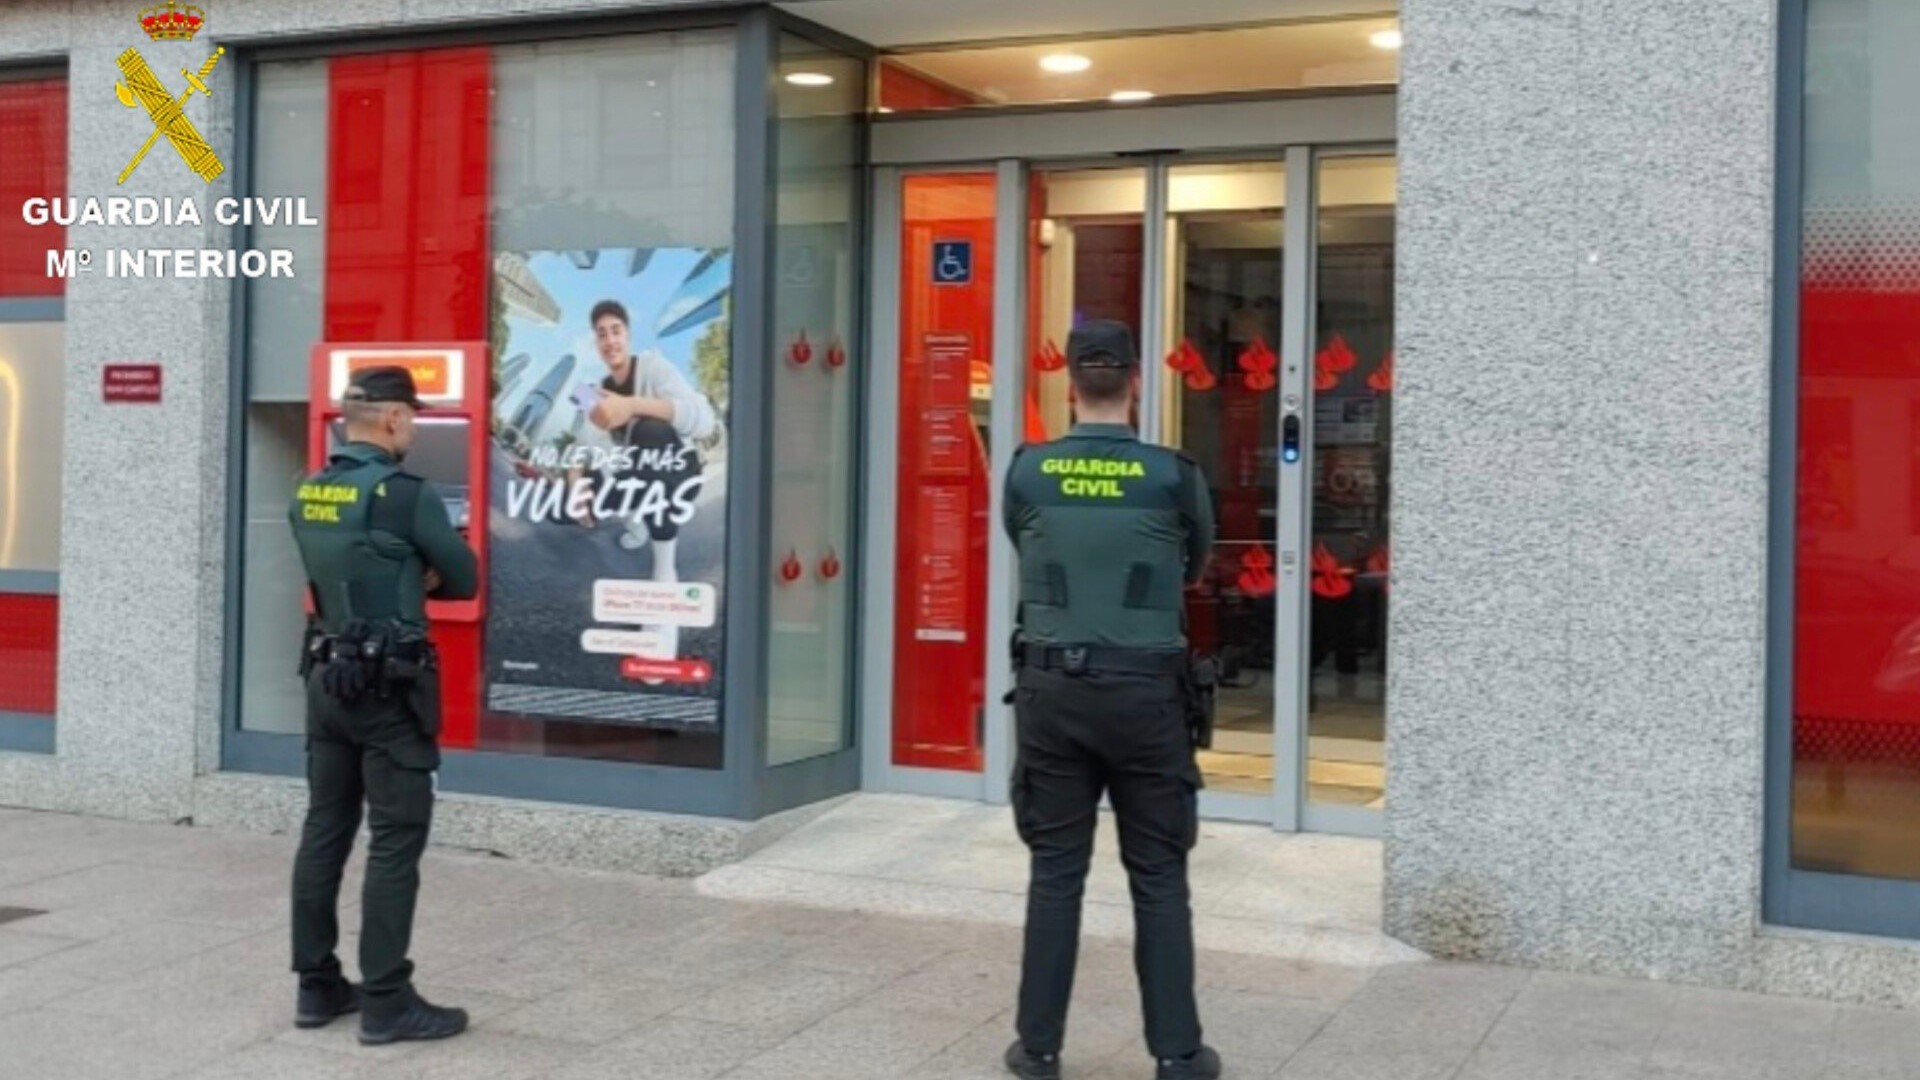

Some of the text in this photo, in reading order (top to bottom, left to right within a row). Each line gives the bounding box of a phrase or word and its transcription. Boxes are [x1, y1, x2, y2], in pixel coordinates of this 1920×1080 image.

[530, 445, 691, 471] NO LE DES MÁS
[1041, 458, 1146, 479] GUARDIA
[1061, 477, 1125, 498] CIVIL
[507, 475, 707, 525] VUELTAS
[303, 503, 341, 523] CIVIL
